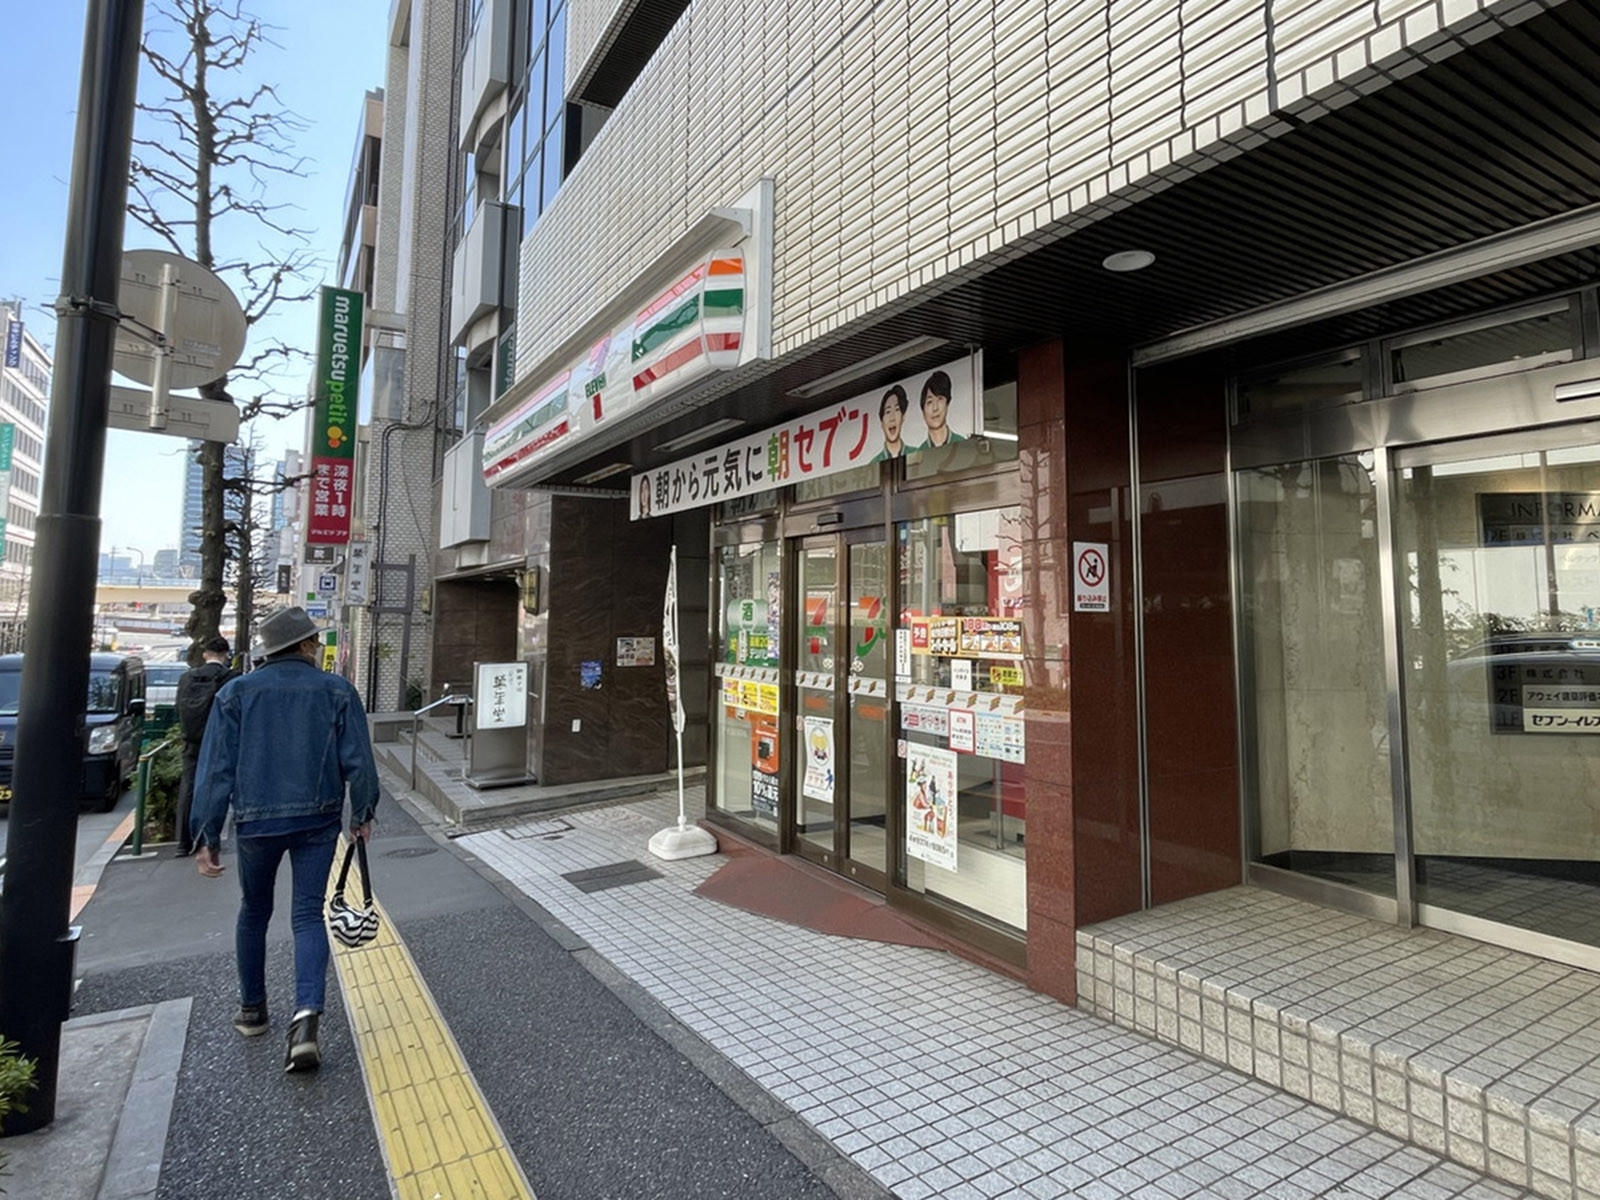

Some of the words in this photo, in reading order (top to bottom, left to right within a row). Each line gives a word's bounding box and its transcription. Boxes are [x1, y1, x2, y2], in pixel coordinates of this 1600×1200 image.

[314, 464, 331, 517] まで営業
[331, 464, 348, 518] 深夜1時
